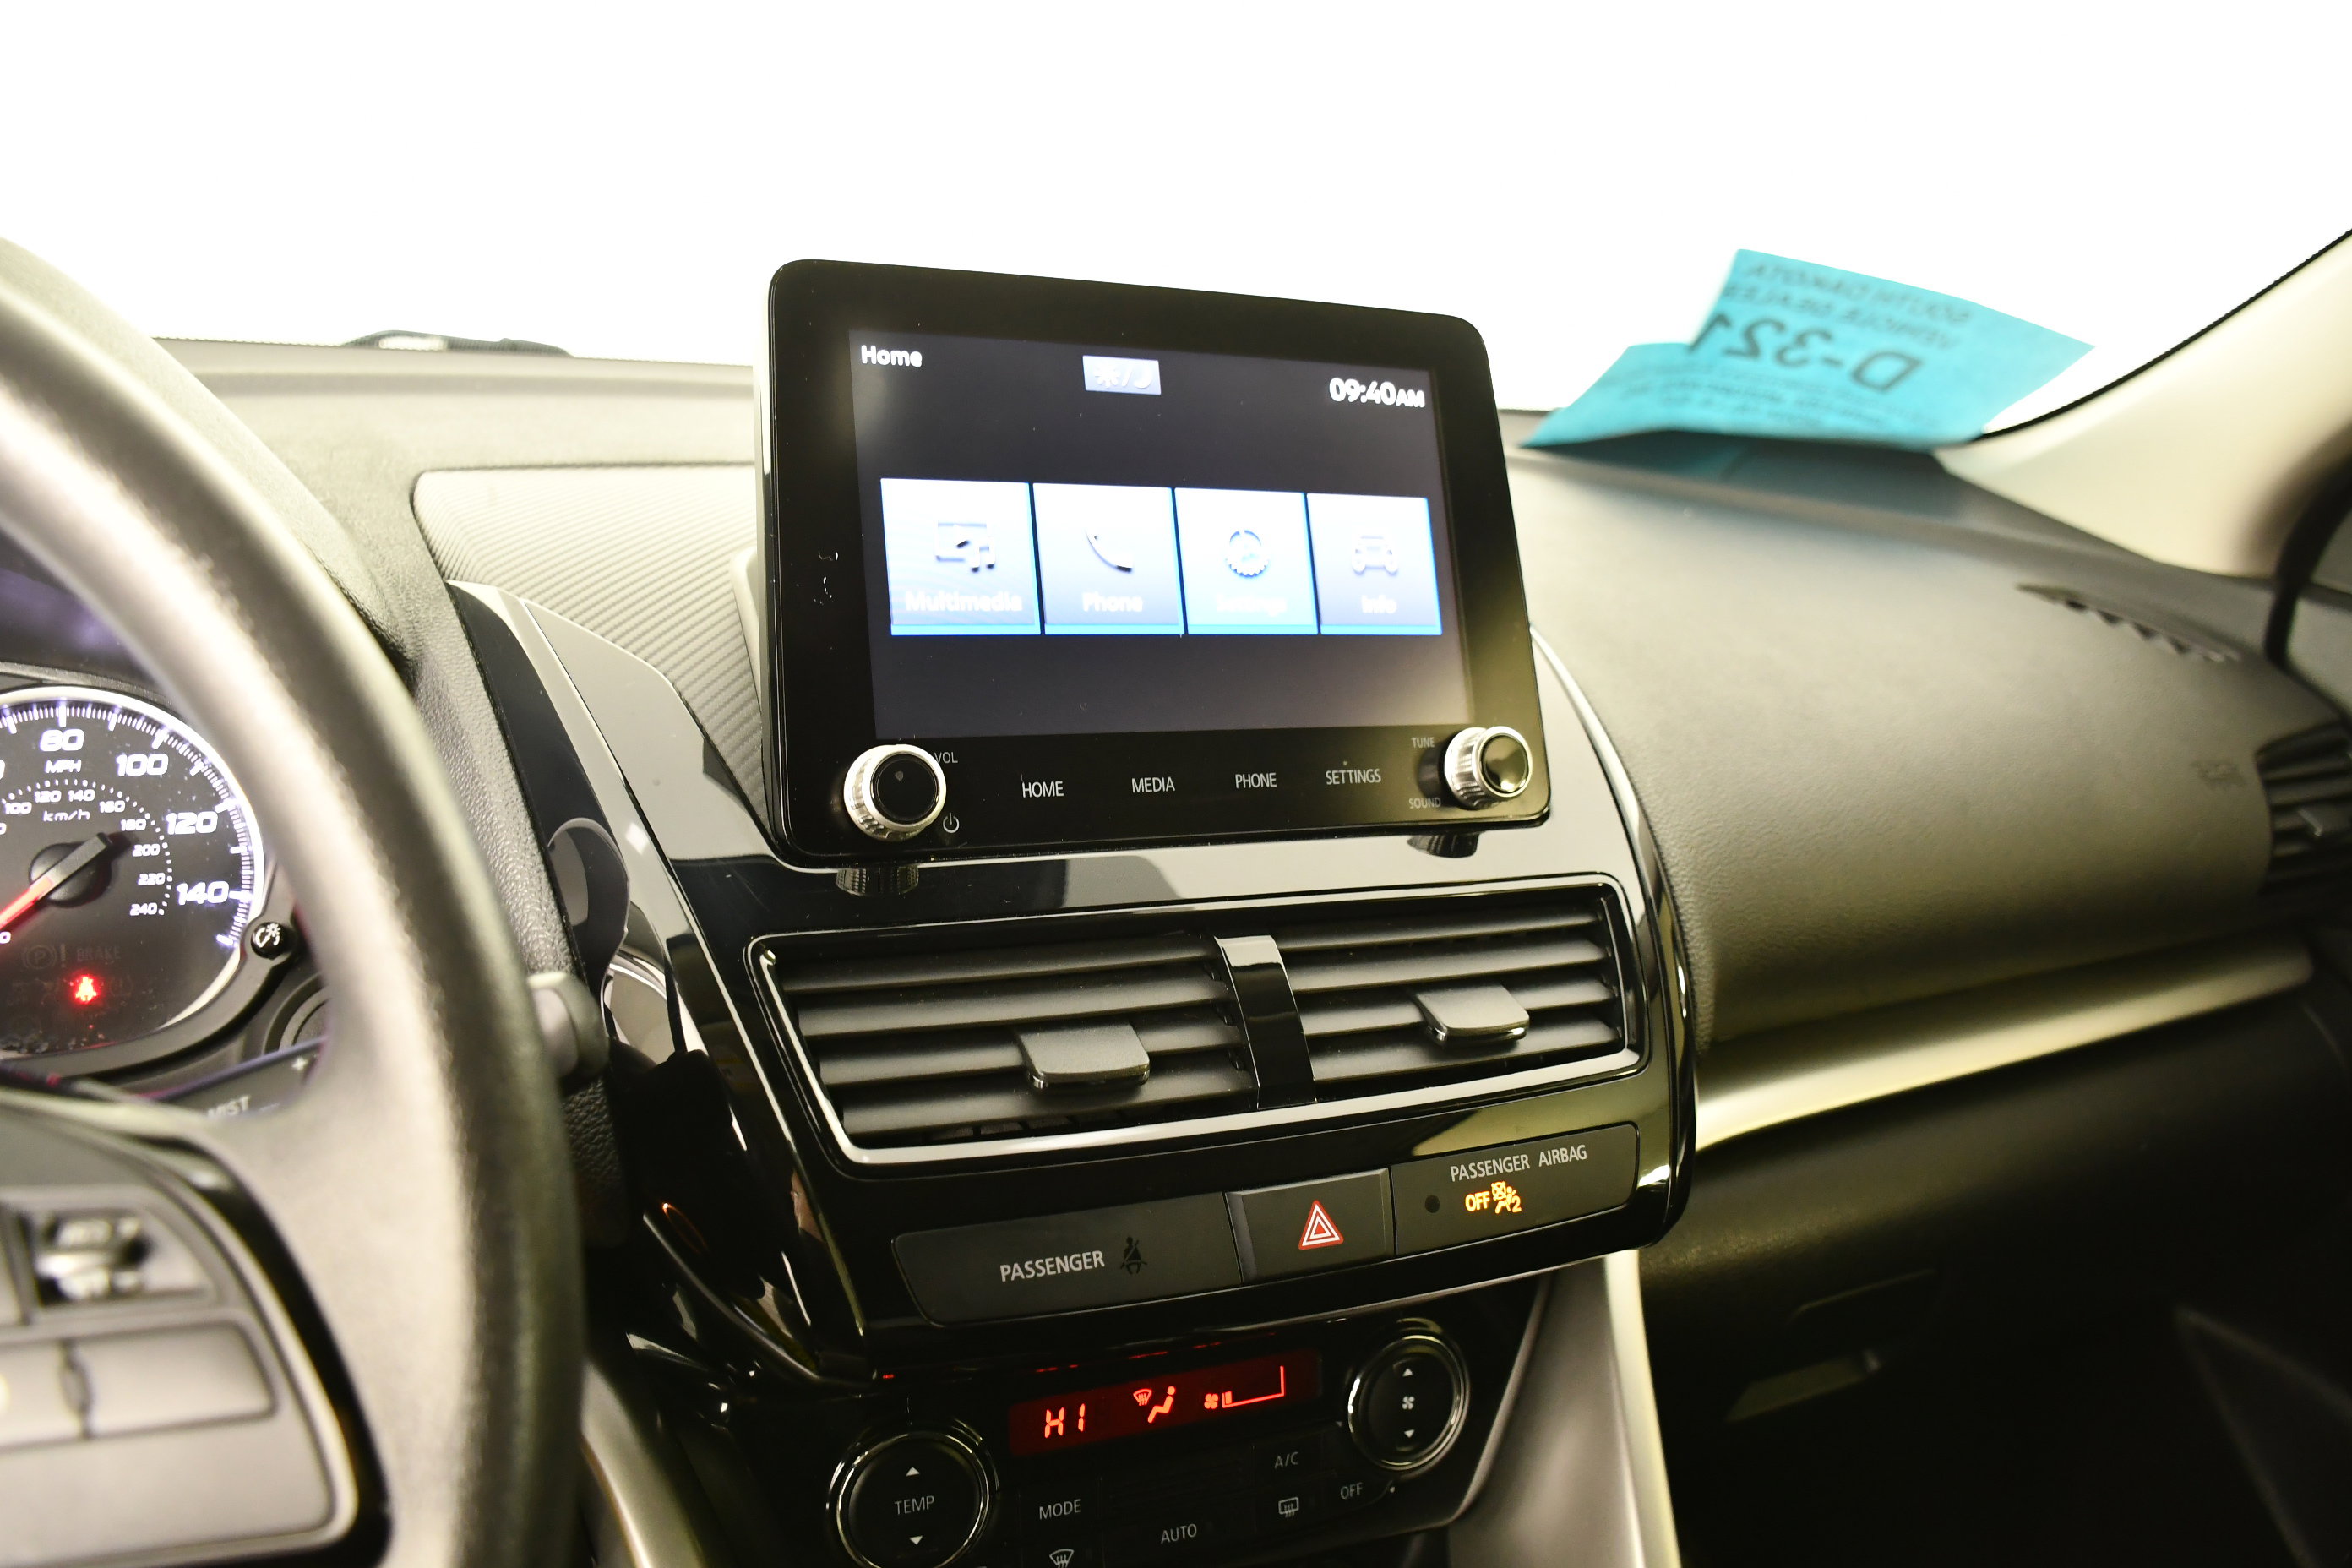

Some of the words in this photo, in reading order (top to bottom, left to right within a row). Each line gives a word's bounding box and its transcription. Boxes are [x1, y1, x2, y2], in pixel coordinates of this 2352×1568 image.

[860, 344, 923, 368] Home
[905, 591, 1022, 614] Multimedia
[1081, 592, 1144, 613] Phone
[40, 729, 85, 752] 80
[1411, 736, 1435, 749] TUNE
[44, 759, 82, 774] MPH
[115, 752, 169, 777] 100
[934, 751, 959, 765] VOL
[1131, 776, 1176, 793] MEDIA
[1235, 772, 1277, 789] PHONE
[1325, 768, 1382, 785] SETTINGS
[34, 790, 62, 803] 120
[68, 788, 95, 803] 140
[1021, 781, 1064, 798] HOME
[2, 801, 33, 815] 100
[99, 800, 126, 814] 160
[1408, 797, 1442, 809] SOUND
[42, 808, 90, 822] km/h
[120, 817, 148, 831] 180
[165, 812, 219, 836] 120
[132, 843, 161, 858] 200
[137, 872, 166, 886] 220
[176, 880, 229, 906] 140
[129, 902, 158, 917] 240
[1449, 1153, 1531, 1183] PASSENGER
[1538, 1144, 1588, 1168] AIRBAG
[1464, 1190, 1491, 1212] OFF
[999, 1250, 1105, 1282] PASSENGER
[1274, 1451, 1298, 1468] A/C
[1340, 1482, 1362, 1500] OFF
[894, 1494, 935, 1515] TEMP
[1039, 1499, 1081, 1519] MODE
[1161, 1523, 1197, 1544] AUTO
